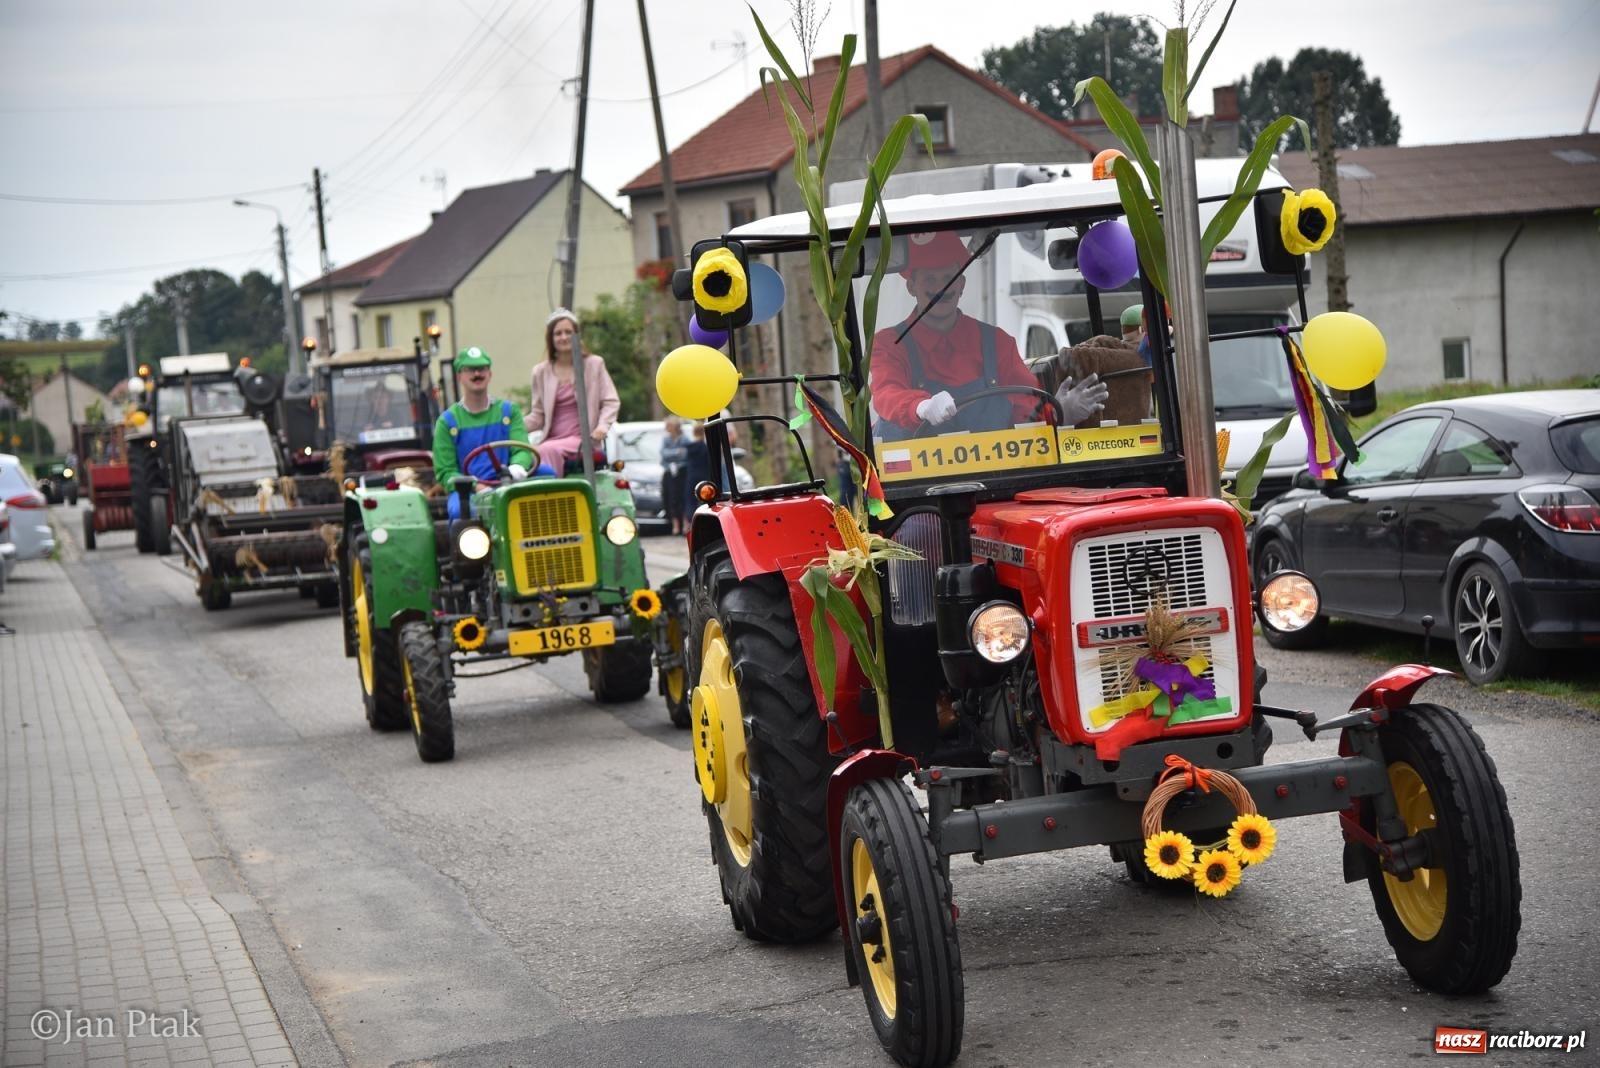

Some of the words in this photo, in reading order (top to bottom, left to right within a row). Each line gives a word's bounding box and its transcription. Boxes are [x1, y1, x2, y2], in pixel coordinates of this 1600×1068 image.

[917, 437, 1050, 467] 11.01.1973
[1065, 438, 1082, 451] BVB
[1087, 438, 1135, 451] GRZEGORZ
[537, 625, 592, 650] 1968
